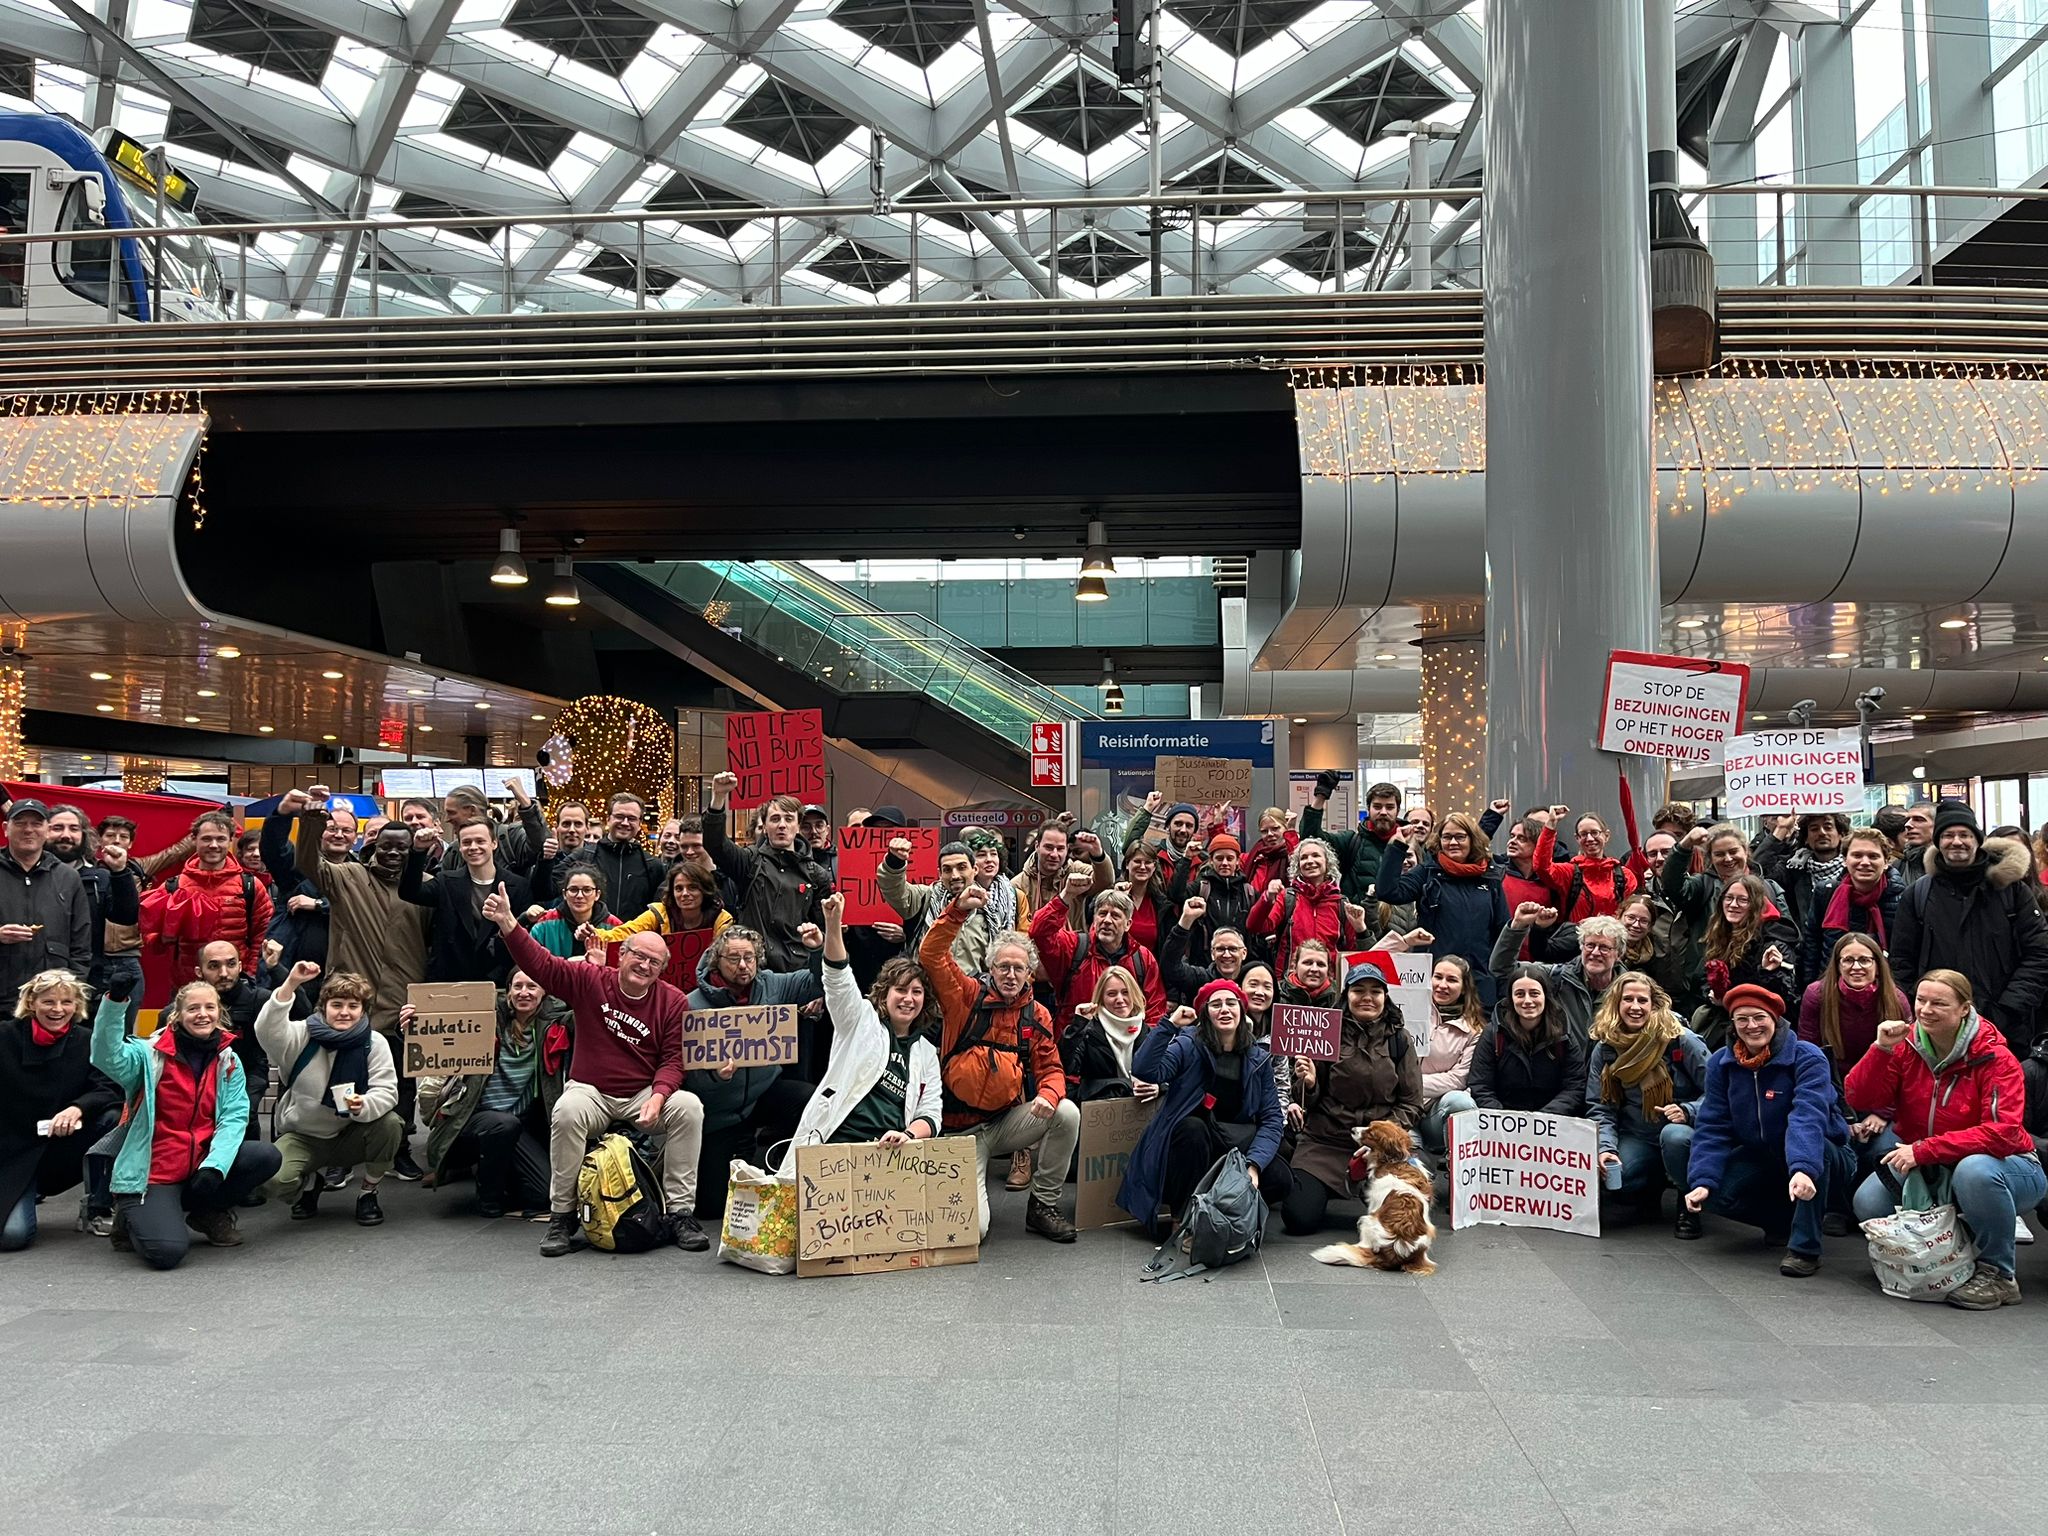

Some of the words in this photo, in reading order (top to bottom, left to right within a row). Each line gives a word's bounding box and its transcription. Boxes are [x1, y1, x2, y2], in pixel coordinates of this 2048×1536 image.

[1644, 682, 1682, 698] STOP
[1686, 686, 1705, 700] DE
[1614, 698, 1730, 723] BEZUINIGINGEN
[727, 716, 756, 742] NO
[768, 712, 816, 736] IF'S
[1616, 718, 1636, 732] OP
[1640, 721, 1668, 736] HET
[1672, 725, 1724, 742] HOGER
[1099, 734, 1210, 748] Reisinformatie
[1624, 739, 1710, 761] ONDERWIJS
[1754, 732, 1798, 746] STOP
[1804, 732, 1825, 745] DE
[728, 741, 760, 772] NO
[771, 737, 822, 762] BUTS
[1725, 751, 1860, 772] BEZUINIGINGEN
[770, 765, 824, 796] CUTS
[1165, 776, 1196, 788] FEED
[1208, 768, 1250, 780] FOOD?
[1730, 776, 1750, 790] OP
[1756, 773, 1788, 786] HET
[1794, 772, 1856, 786] HOGER
[1742, 792, 1844, 808] ONDERWIJS
[952, 813, 1004, 824] Statiegeld
[684, 1006, 790, 1034] Onderwijs
[1282, 1008, 1330, 1029] KENNIS
[1278, 1036, 1334, 1056] VIJAND
[1478, 1113, 1528, 1134] STOP
[1534, 1119, 1558, 1138] DE
[820, 1156, 857, 1178] EVEN
[864, 1152, 882, 1168] MY
[886, 1150, 960, 1179] MICROBES
[1458, 1140, 1592, 1171] BEZUINIGINGEN
[1462, 1168, 1477, 1186] OP
[1479, 1166, 1514, 1186] HET
[1520, 1170, 1586, 1197] HOGER
[818, 1188, 846, 1206] CAN
[853, 1187, 896, 1202] THINK
[1470, 1192, 1572, 1221] ONDERWIJS
[816, 1209, 887, 1240] BIGGER
[898, 1208, 934, 1226] THAN
[938, 1206, 974, 1231] THIS!
